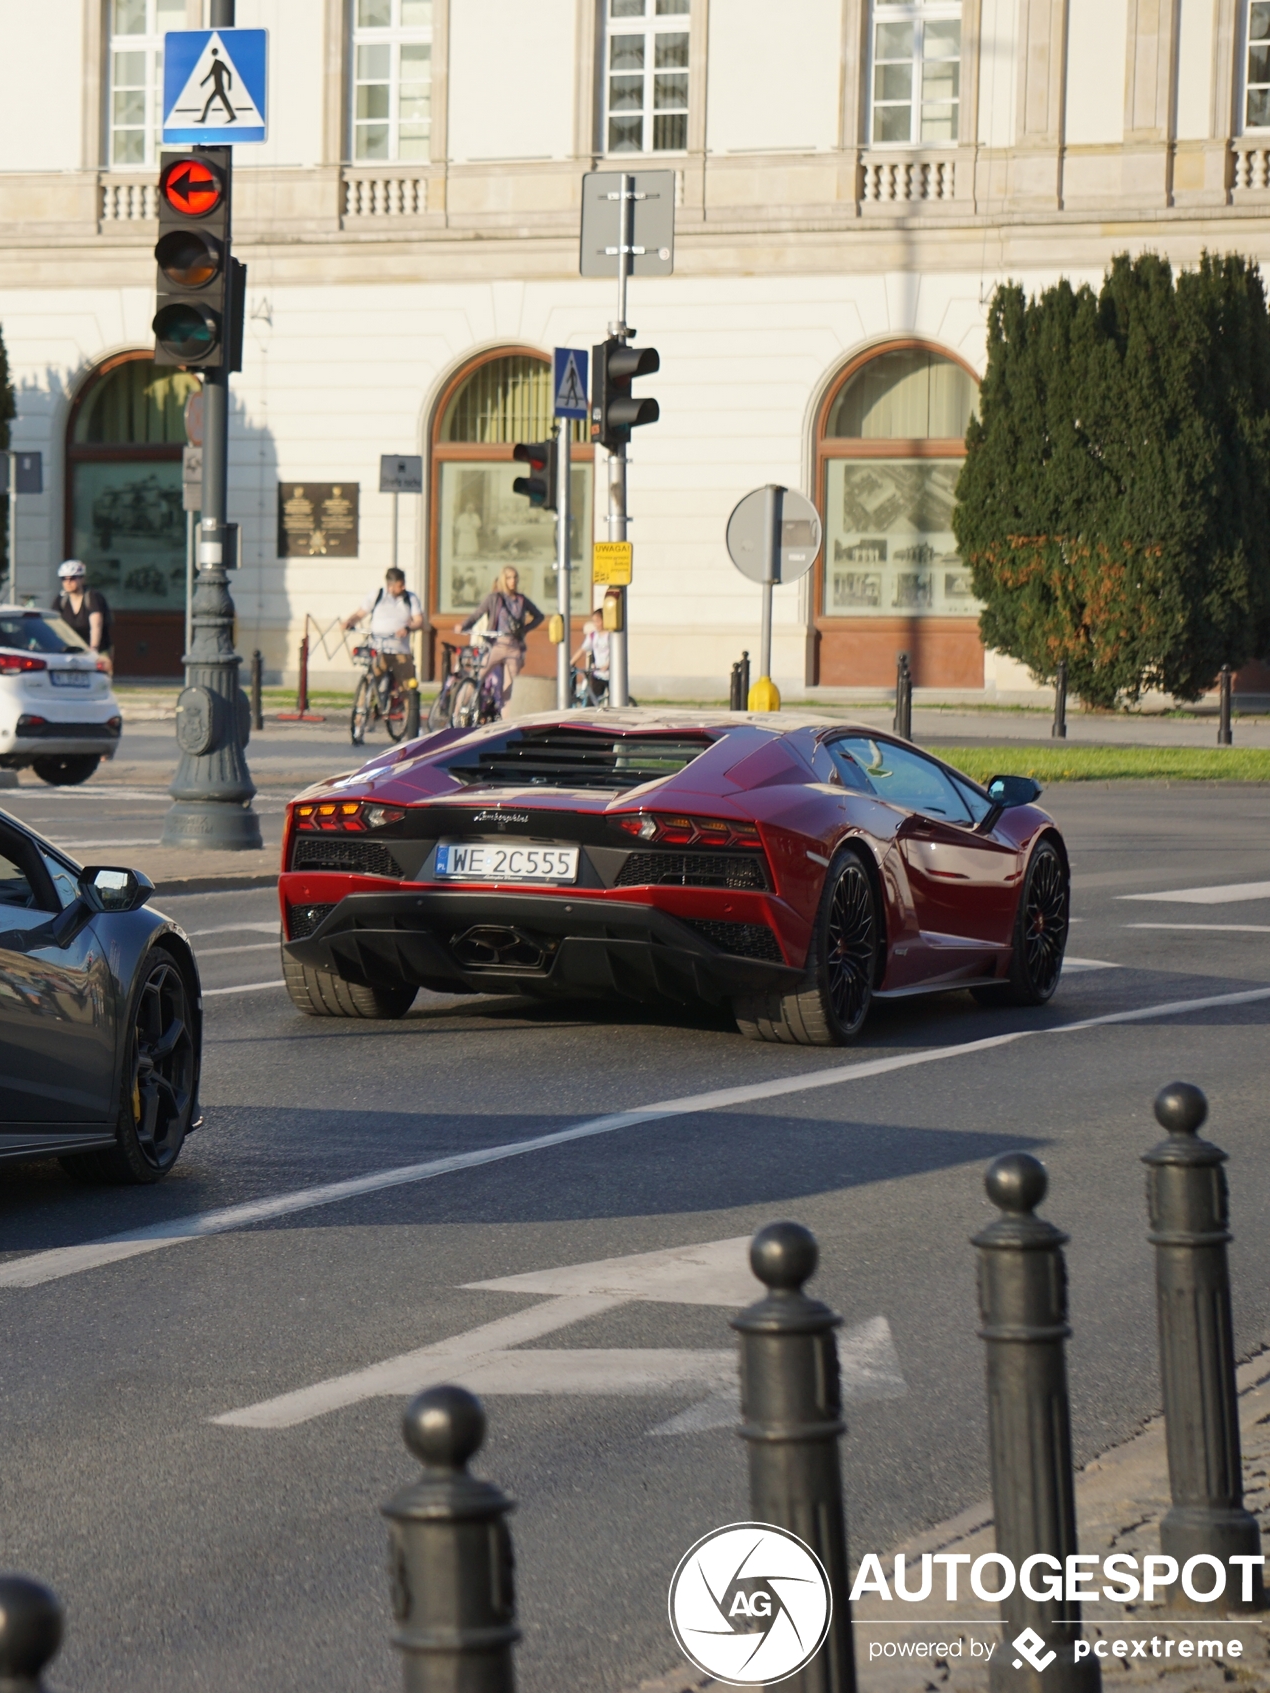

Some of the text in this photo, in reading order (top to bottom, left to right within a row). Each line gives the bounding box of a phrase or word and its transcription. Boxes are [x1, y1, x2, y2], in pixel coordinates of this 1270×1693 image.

[595, 545, 630, 553] UWAGA!
[474, 811, 529, 823] Lamborghini
[453, 849, 571, 876] WE 2C555
